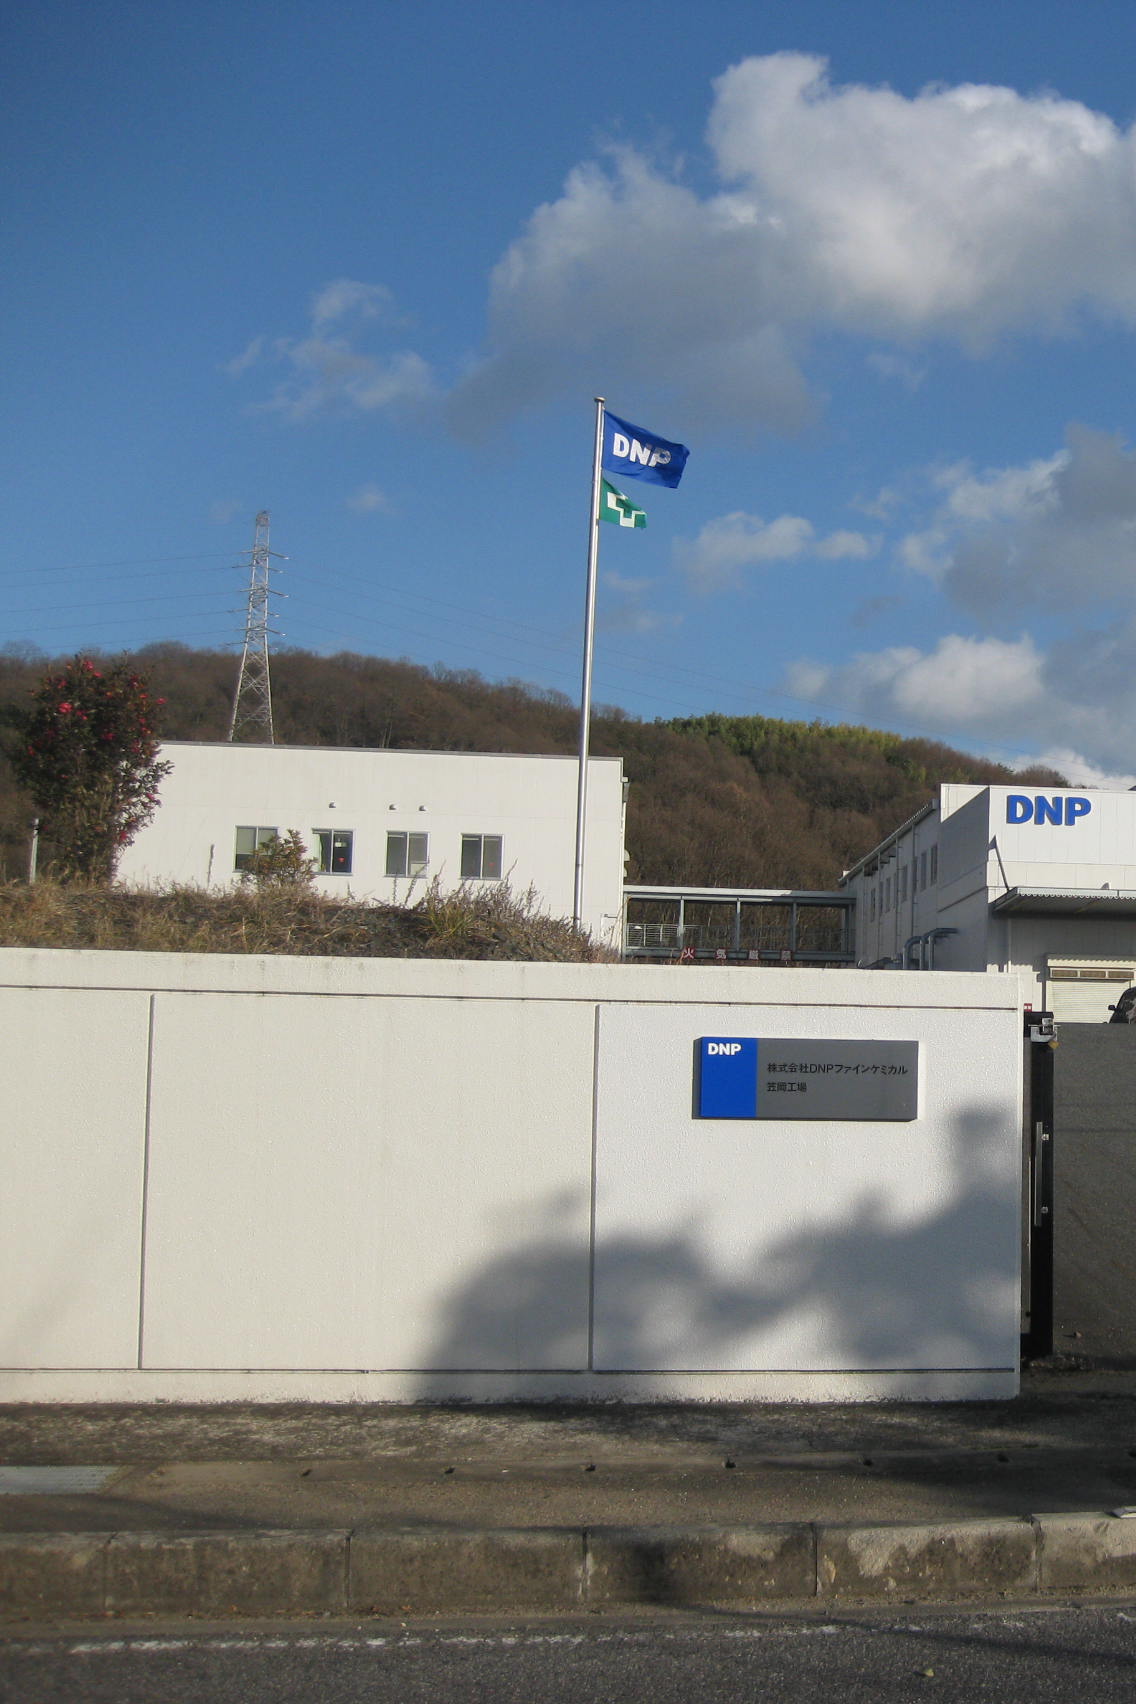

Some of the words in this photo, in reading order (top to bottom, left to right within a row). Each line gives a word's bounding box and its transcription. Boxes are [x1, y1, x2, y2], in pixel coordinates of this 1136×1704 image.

[613, 432, 671, 467] DNP
[1006, 794, 1091, 826] DNP
[707, 1042, 742, 1056] DNP
[767, 1063, 908, 1076] 株式会社DNPファインケミカル
[766, 1081, 807, 1092] 笠岡工場
